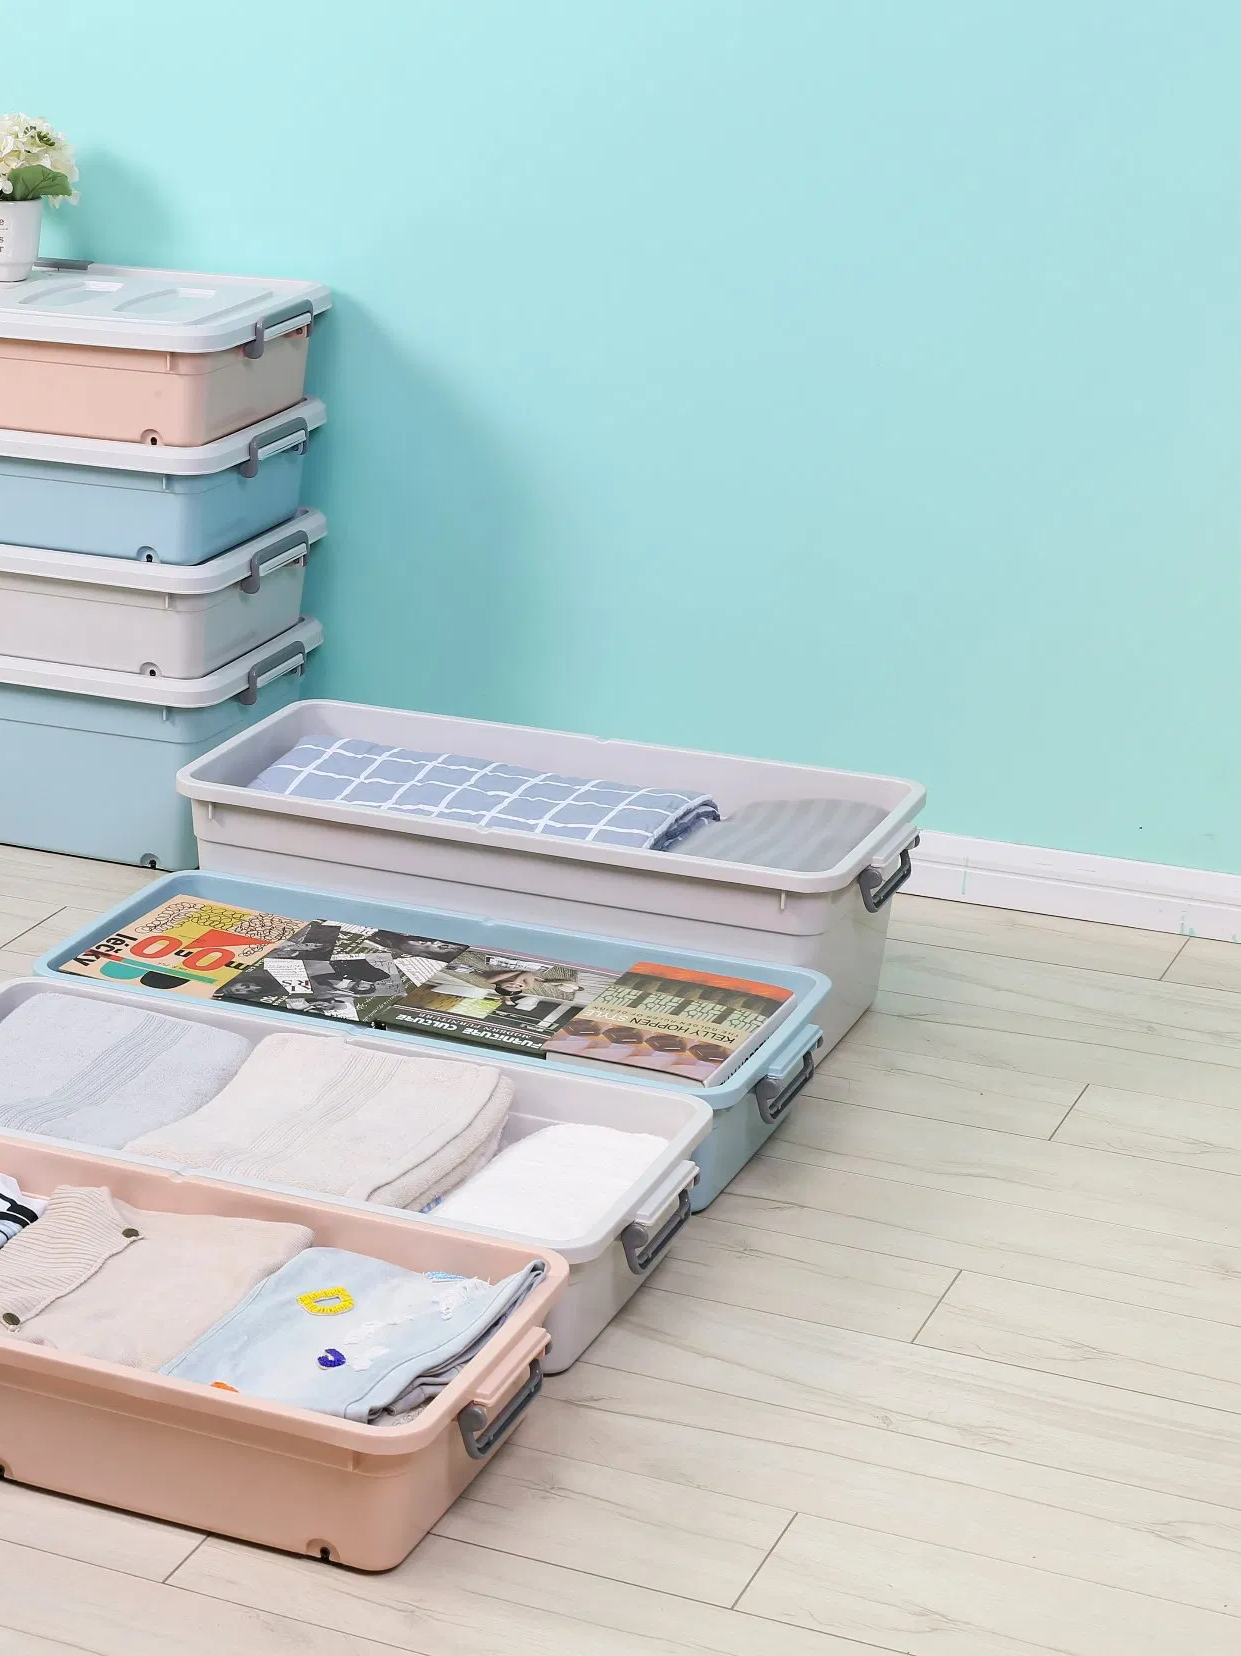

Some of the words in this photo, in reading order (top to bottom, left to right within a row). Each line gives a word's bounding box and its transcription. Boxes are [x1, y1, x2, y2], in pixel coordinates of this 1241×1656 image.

[395, 1013, 458, 1031] CULTURE
[418, 1012, 481, 1029] FURNITURE
[583, 1009, 629, 1022] STYLE
[483, 1025, 531, 1039] MODERN
[629, 1017, 690, 1034] HOPPEN
[679, 1020, 718, 1032] GOLDEN
[689, 1028, 736, 1044] KELLY
